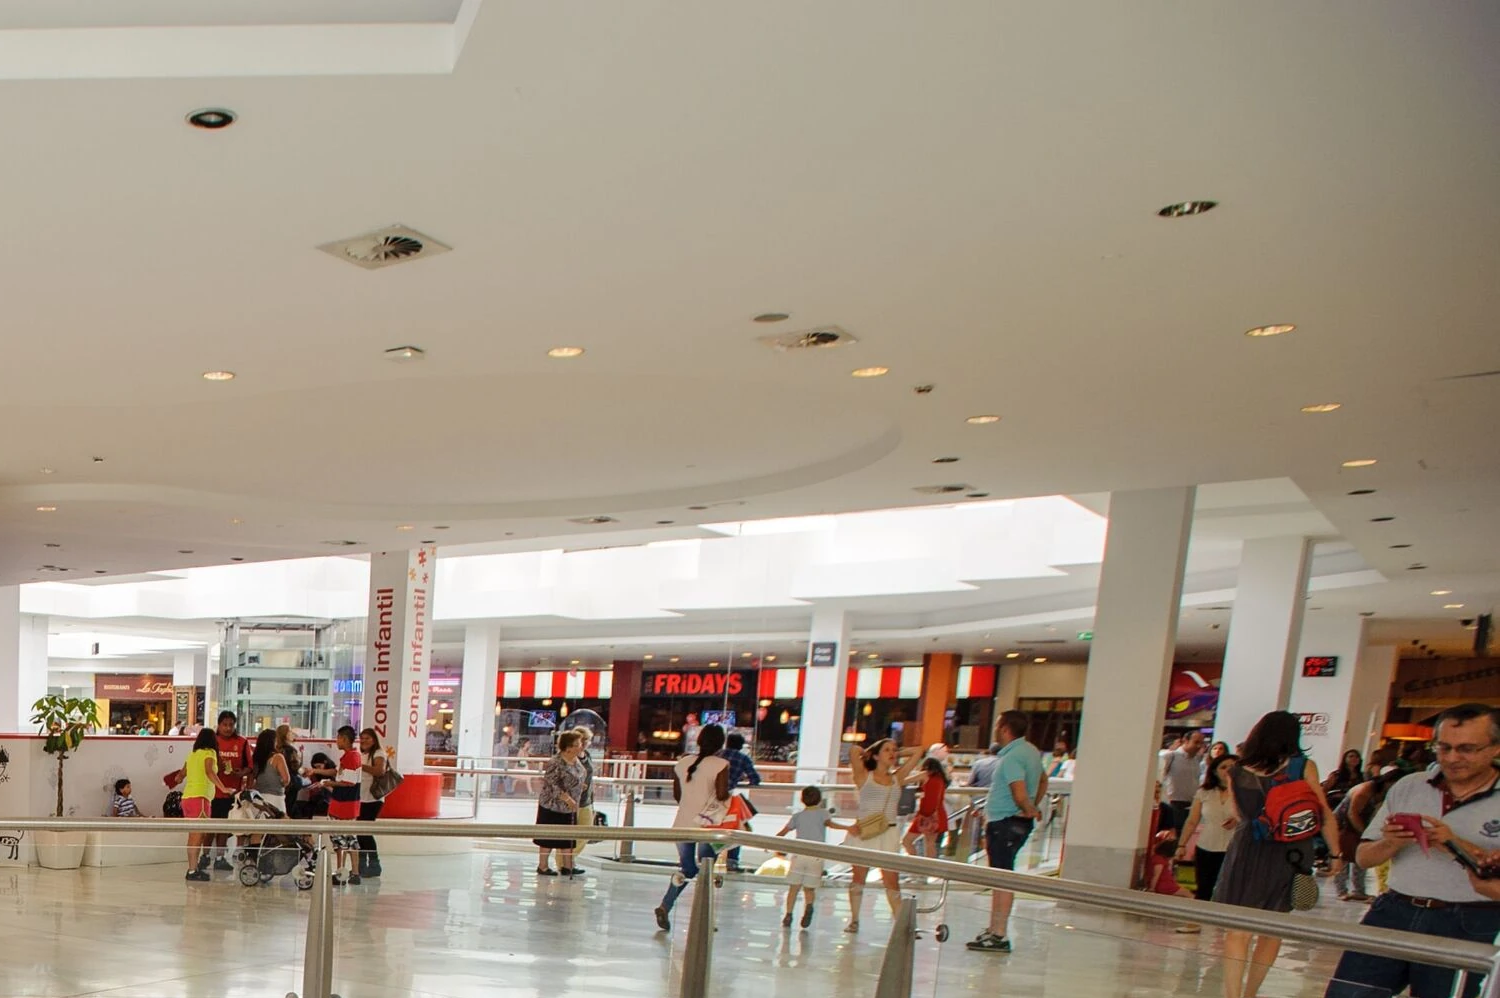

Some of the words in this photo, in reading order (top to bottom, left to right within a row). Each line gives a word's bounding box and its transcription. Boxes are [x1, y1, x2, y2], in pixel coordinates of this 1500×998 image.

[373, 588, 394, 672] infantil
[410, 588, 426, 672] infantil
[374, 680, 389, 739] zona
[408, 680, 421, 739] zona
